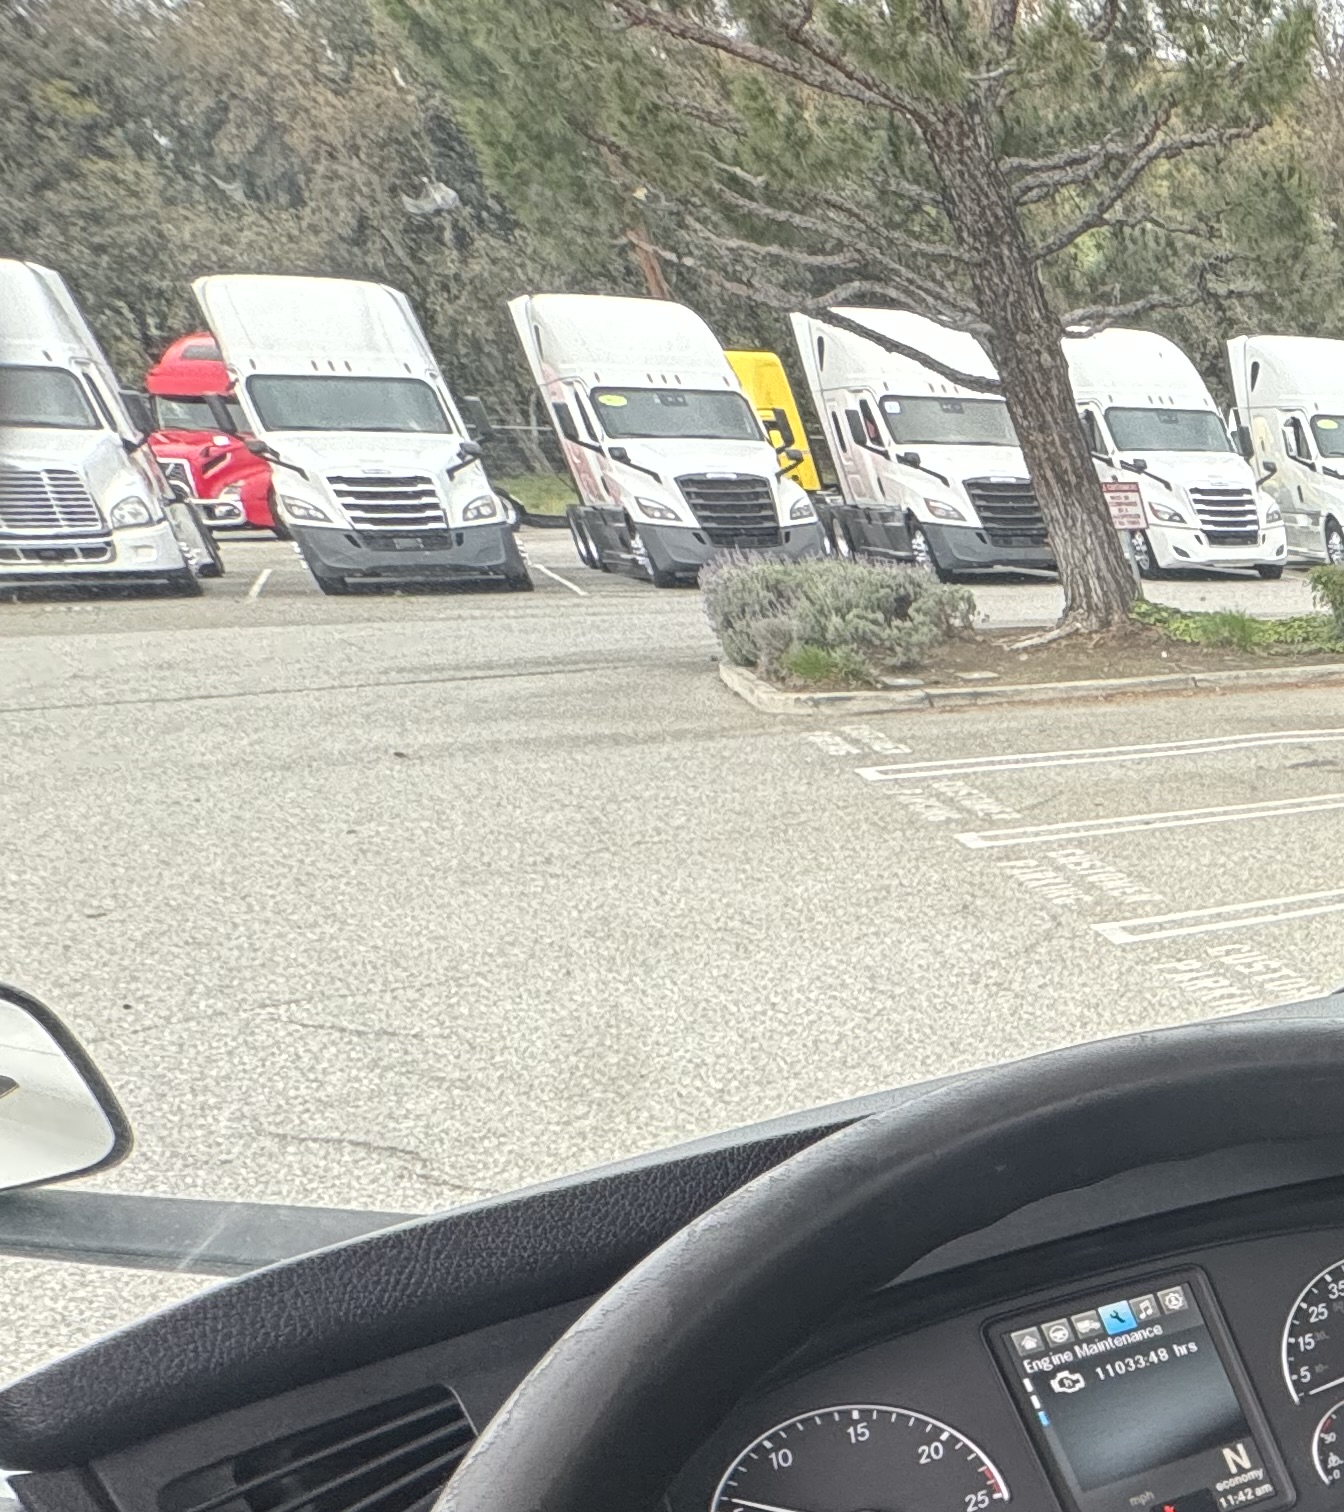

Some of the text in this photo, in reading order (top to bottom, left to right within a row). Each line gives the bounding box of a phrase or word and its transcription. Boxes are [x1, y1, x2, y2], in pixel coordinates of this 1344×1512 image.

[1308, 1303, 1328, 1323] 25
[1023, 1324, 1163, 1373] Engine Maintenance
[1298, 1336, 1315, 1352] 15
[1096, 1341, 1198, 1380] 11033:48 hrs
[1300, 1366, 1311, 1383] 5
[846, 1423, 870, 1444] 15
[768, 1449, 793, 1471] 10
[917, 1442, 944, 1464] 20
[1221, 1443, 1252, 1474] N
[1215, 1467, 1264, 1492] economy
[964, 1490, 990, 1512] 25
[1129, 1491, 1156, 1507] mph
[1219, 1483, 1273, 1508] 11:42 am
